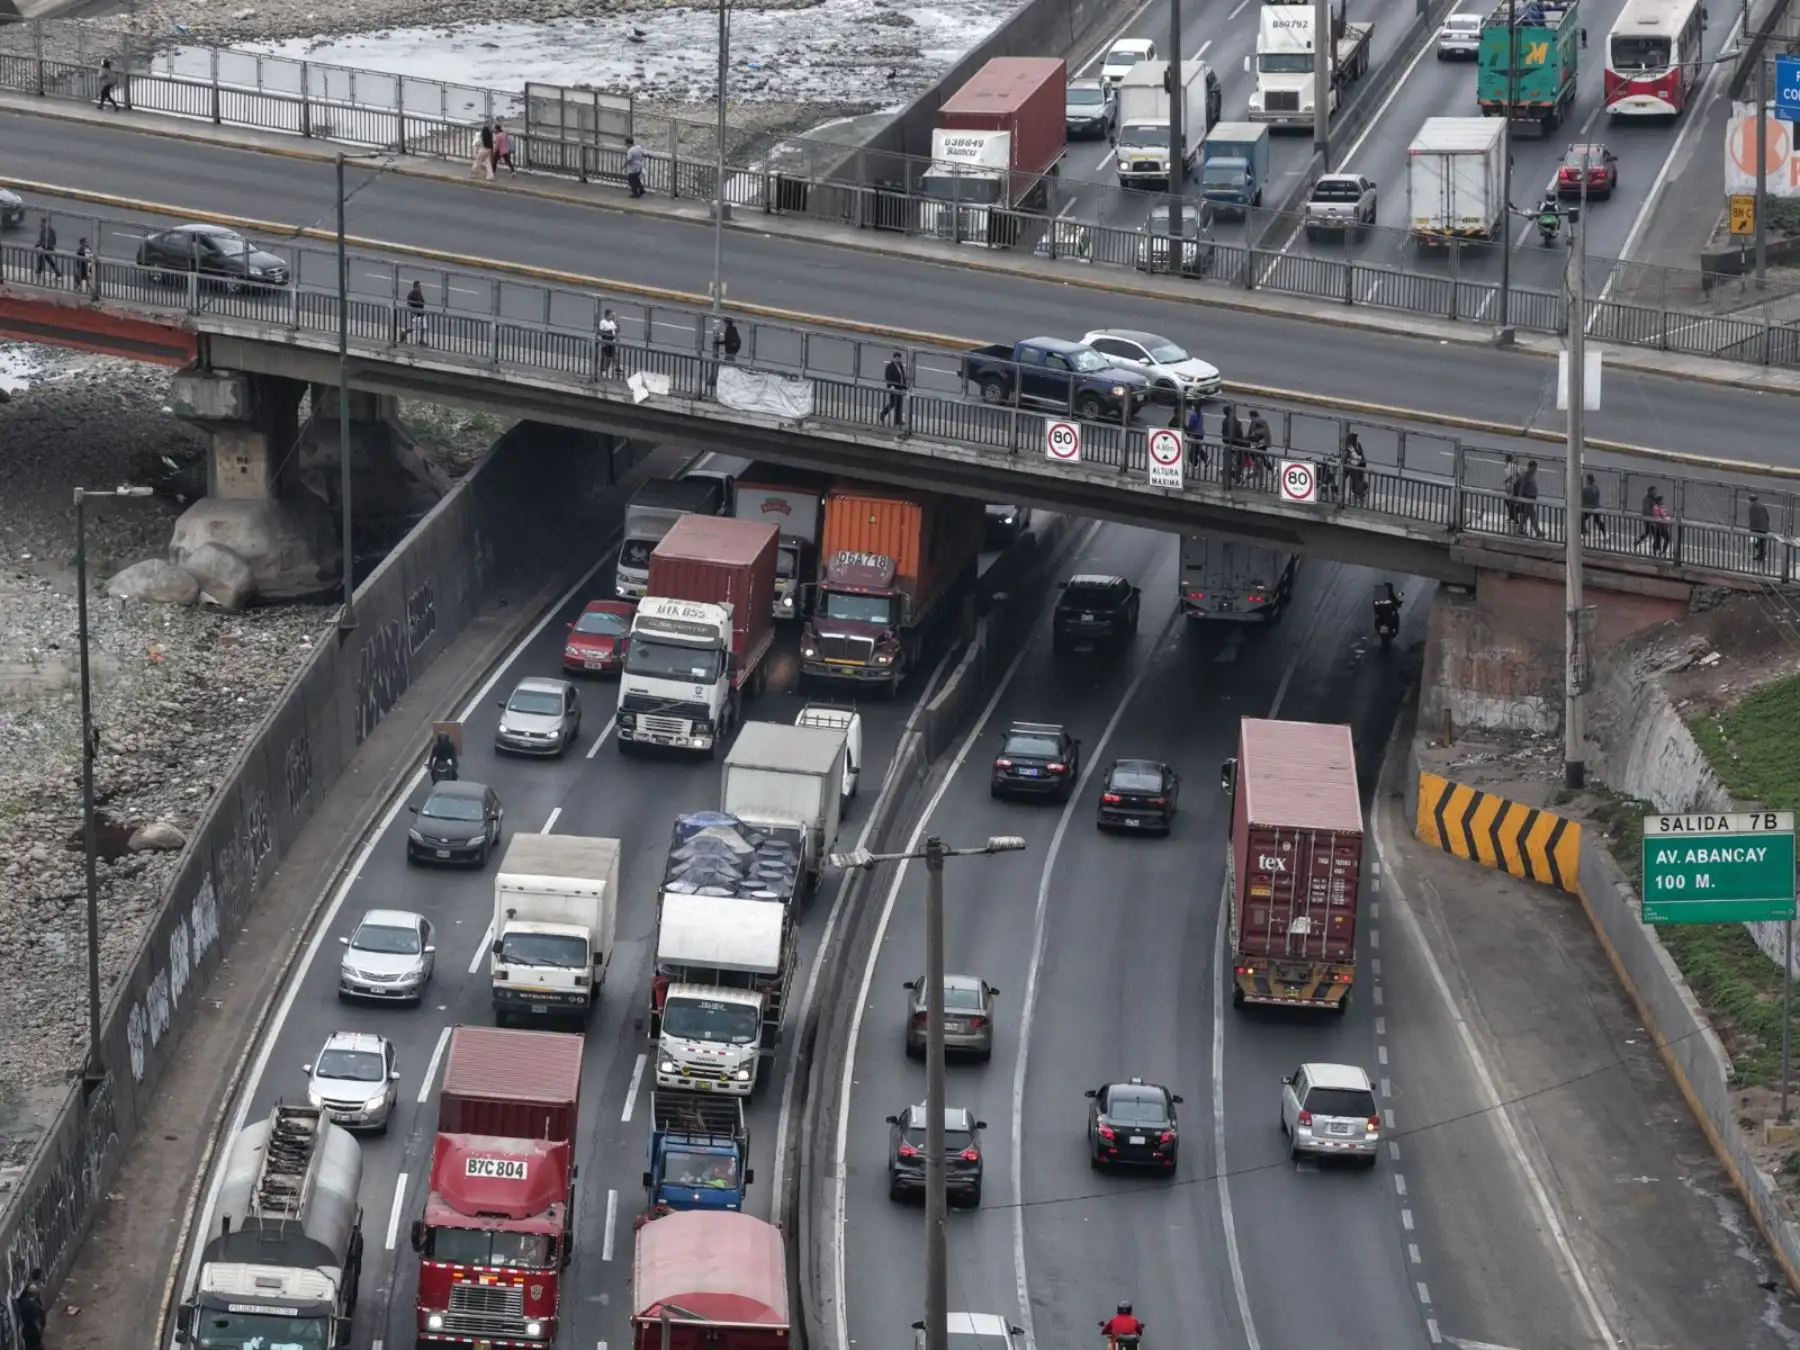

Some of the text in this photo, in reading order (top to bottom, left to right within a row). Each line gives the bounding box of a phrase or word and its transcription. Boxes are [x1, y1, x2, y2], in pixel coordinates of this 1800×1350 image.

[1053, 430, 1073, 445] 80
[1152, 466, 1179, 477] ALTURA
[1288, 471, 1308, 486] 80
[1660, 814, 1777, 832] SALIDA 7B
[1258, 853, 1287, 872] tex
[1656, 847, 1767, 864] AV. ABANCAY
[1655, 874, 1715, 889] 100 M.
[468, 1159, 523, 1178] B7C 804
